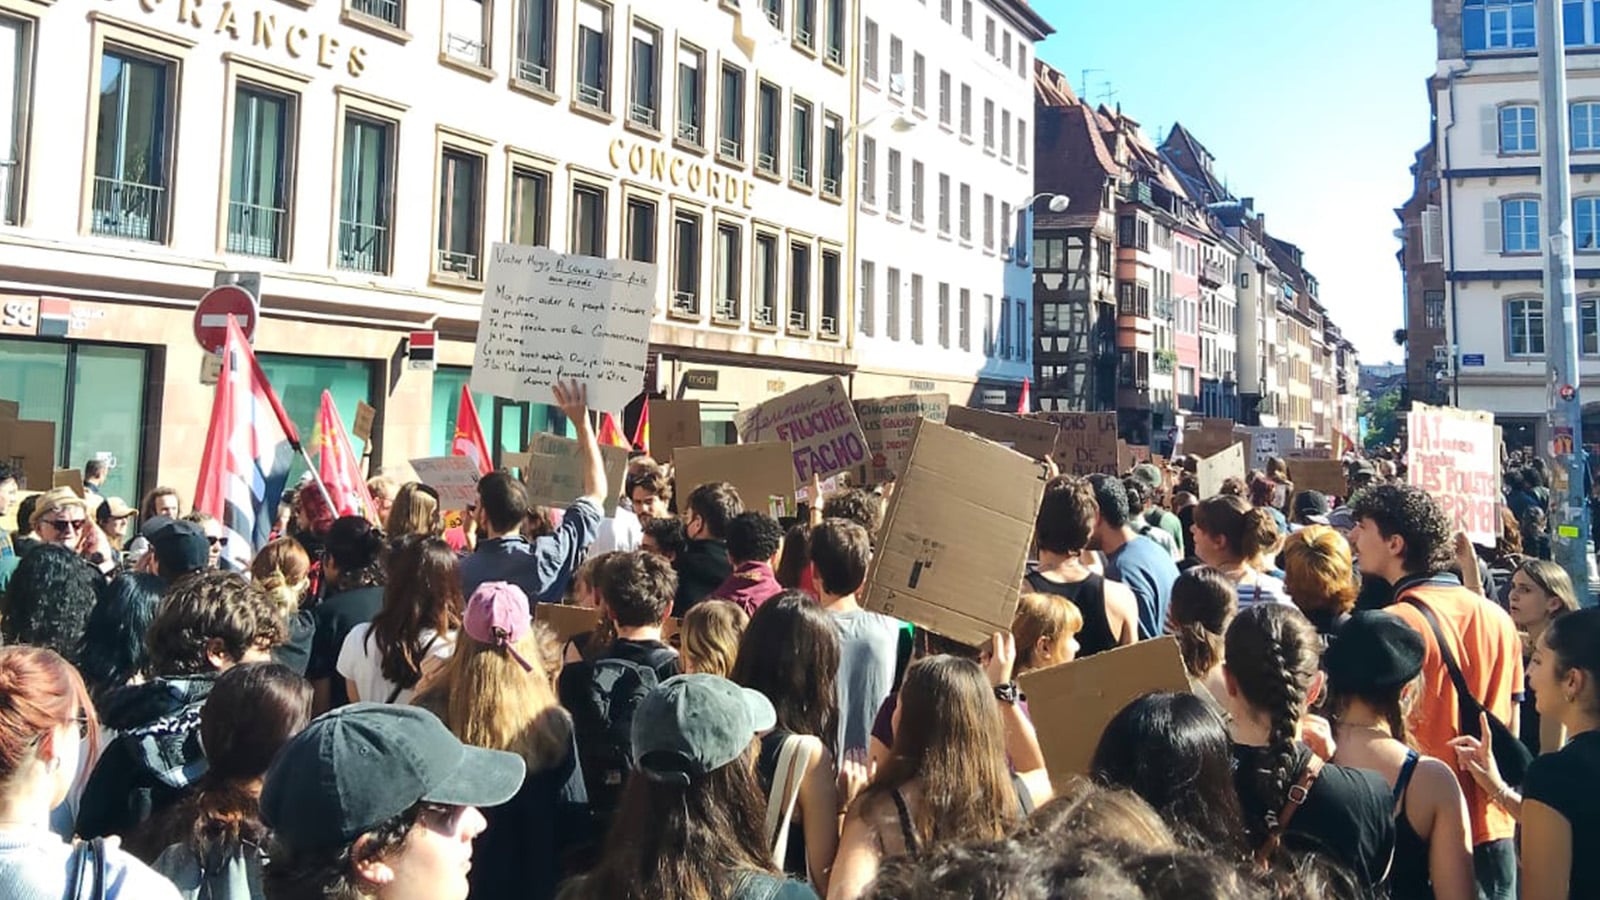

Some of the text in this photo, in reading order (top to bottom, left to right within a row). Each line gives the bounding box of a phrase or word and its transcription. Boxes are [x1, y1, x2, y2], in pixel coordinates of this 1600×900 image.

[608, 138, 755, 210] CONCORDE
[496, 248, 522, 265] Victor
[793, 431, 864, 482] FACHO
[1075, 447, 1098, 463] DE
